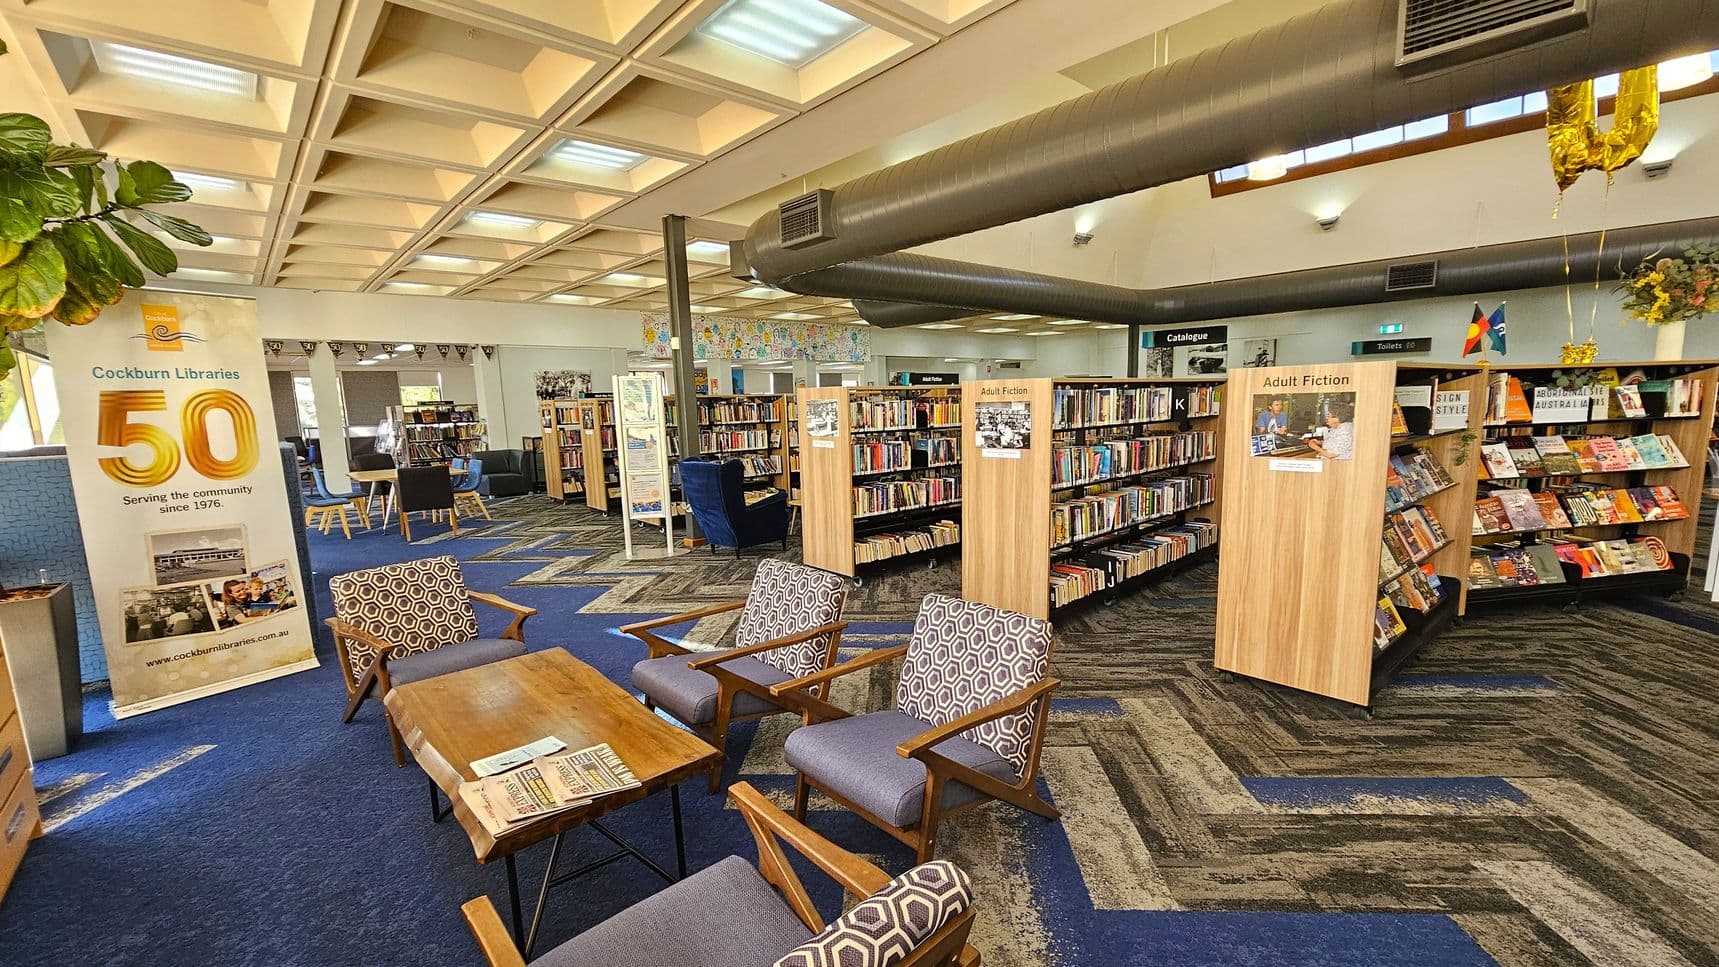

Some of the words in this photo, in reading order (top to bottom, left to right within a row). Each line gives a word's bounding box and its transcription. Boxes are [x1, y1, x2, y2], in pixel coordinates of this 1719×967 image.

[1167, 332, 1208, 342] Catalogue
[271, 342, 281, 350] 50
[304, 342, 314, 350] 50
[92, 366, 170, 379] Cockburn
[175, 368, 240, 379] Libraries
[1263, 376, 1297, 387] Adult
[1303, 375, 1349, 386] Fiction
[981, 387, 1000, 395] Adult
[1002, 387, 1028, 395] Fiction
[1175, 398, 1185, 410] K
[1436, 394, 1461, 402] SIGN
[1436, 405, 1467, 414] STYLE
[97, 388, 260, 488] 50
[123, 493, 168, 506] Serving
[171, 491, 189, 500] the
[193, 485, 253, 498] community
[159, 502, 189, 514] since
[194, 499, 224, 510] 1976.
[1107, 576, 1115, 588] J
[145, 630, 289, 668] www.cockburnlibraries.com.au
